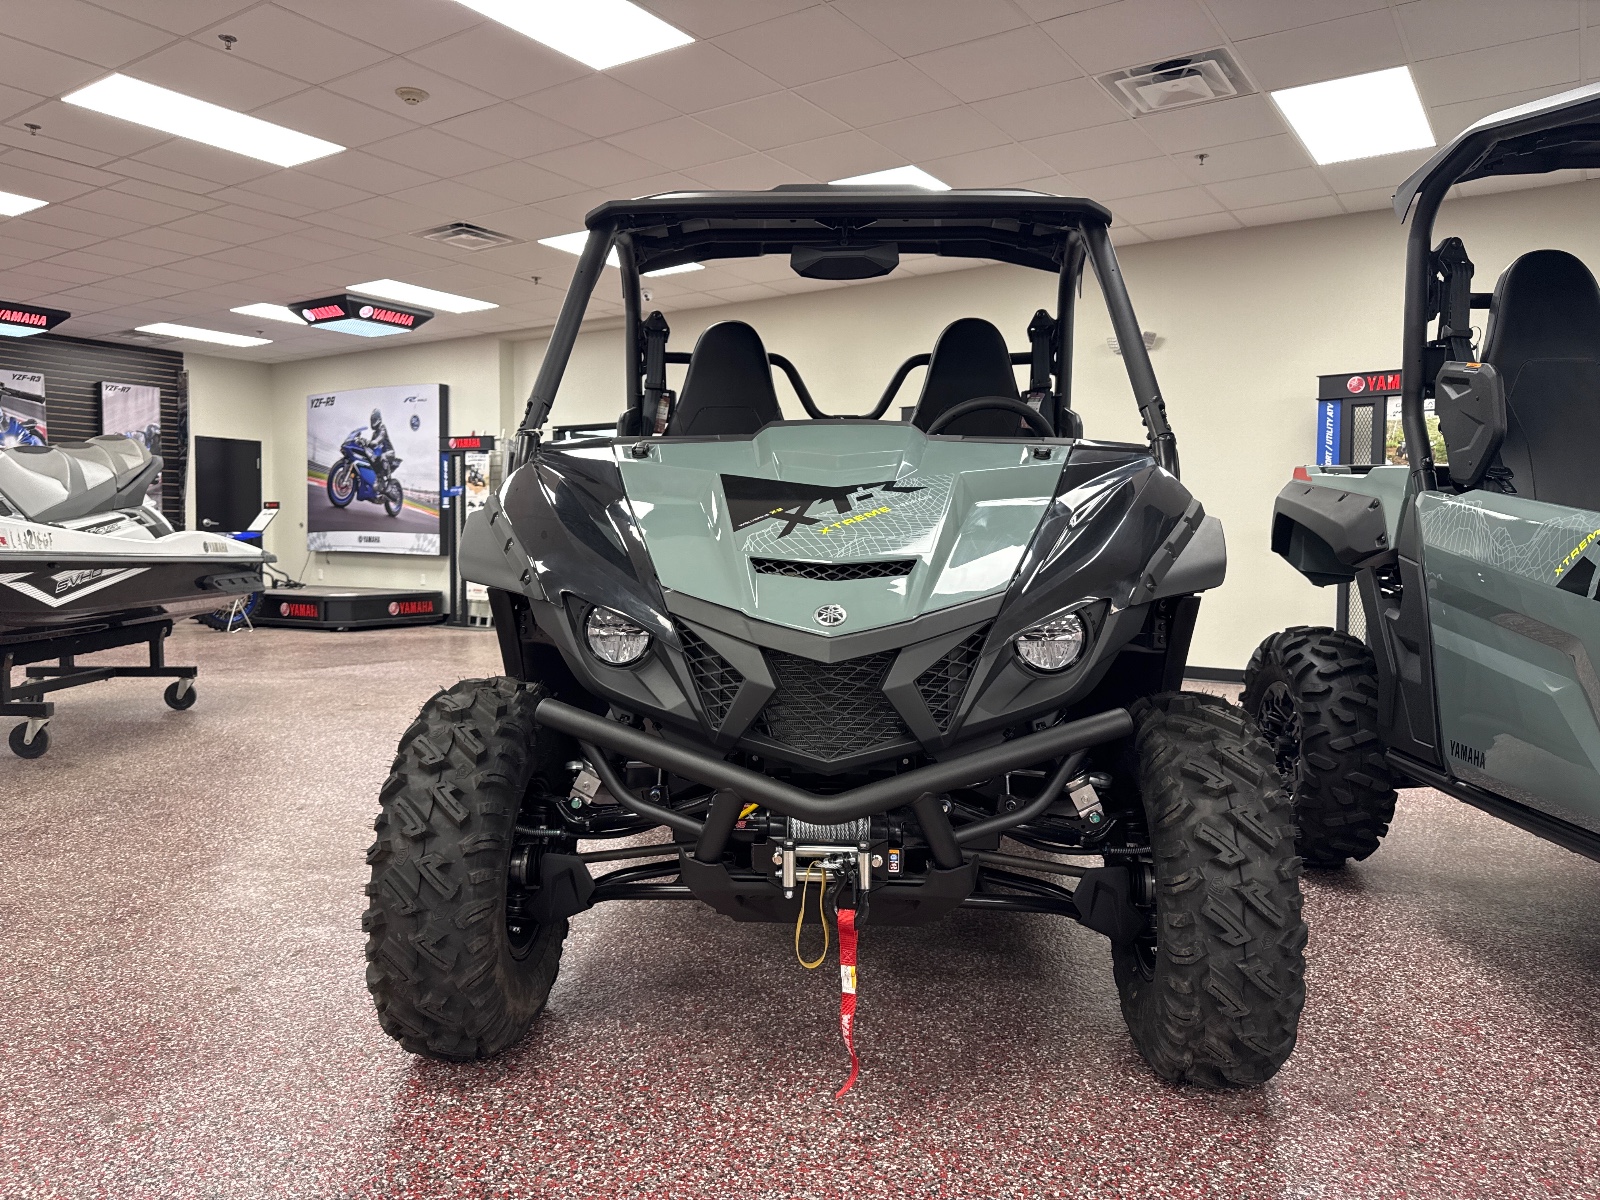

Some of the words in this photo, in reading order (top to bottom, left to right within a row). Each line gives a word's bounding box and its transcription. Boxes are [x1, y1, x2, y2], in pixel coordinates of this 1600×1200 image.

[0, 309, 47, 326] YAMAHA
[372, 308, 415, 326] YAMAHA
[11, 373, 42, 383] YZF-R3
[1366, 374, 1403, 392] YAM
[104, 384, 132, 394] YZF-R7
[310, 396, 336, 409] YZF-R9
[1326, 402, 1334, 418] ATV
[1325, 416, 1334, 445] UTILITY
[456, 438, 481, 448] YAMAHA
[1324, 450, 1333, 466] ORT
[816, 506, 892, 535] XTREME
[208, 541, 228, 553] YAMAHA
[399, 601, 434, 615] YAMAHA
[1450, 739, 1486, 770] YAMAHA
